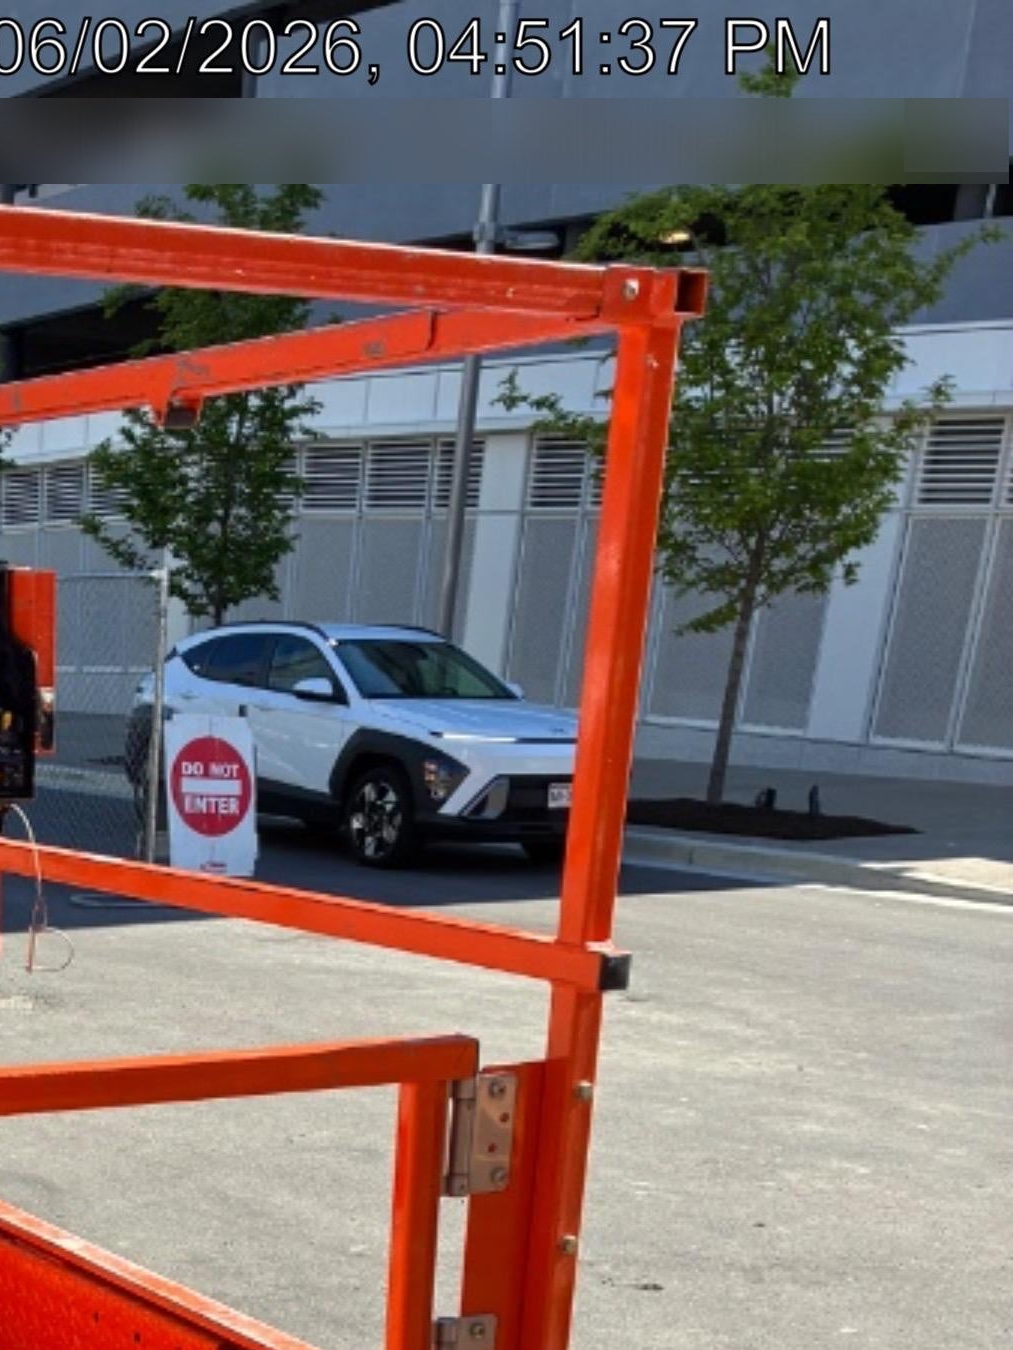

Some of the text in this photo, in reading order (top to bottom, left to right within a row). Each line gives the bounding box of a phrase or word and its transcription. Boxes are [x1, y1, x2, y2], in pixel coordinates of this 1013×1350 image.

[181, 761, 240, 778] DO NOT
[183, 794, 240, 815] ENTER
